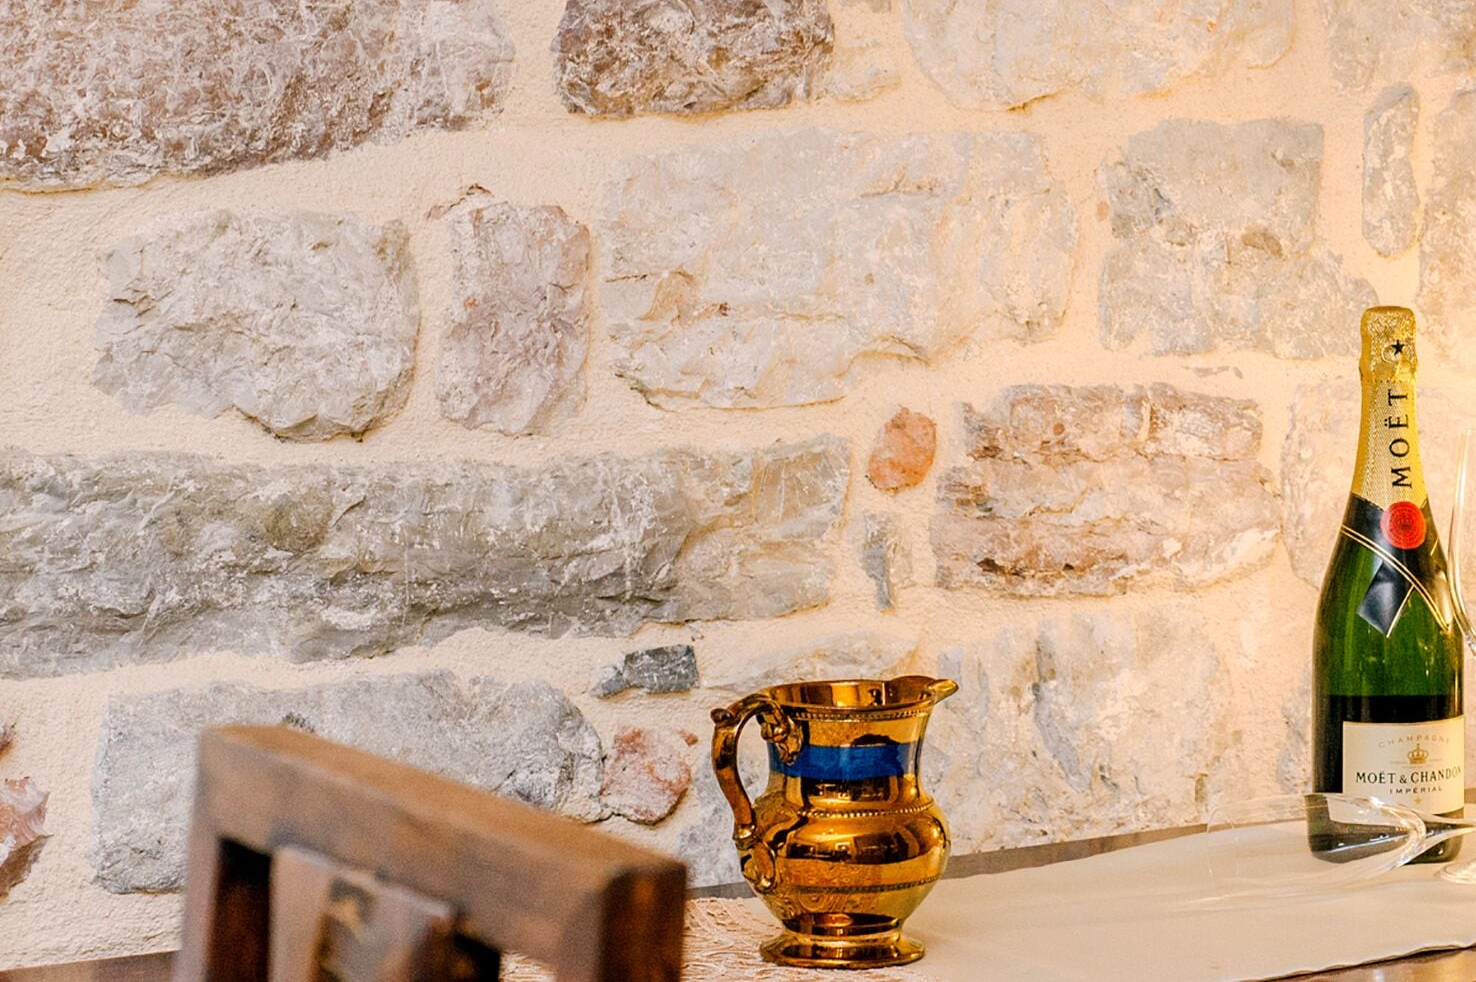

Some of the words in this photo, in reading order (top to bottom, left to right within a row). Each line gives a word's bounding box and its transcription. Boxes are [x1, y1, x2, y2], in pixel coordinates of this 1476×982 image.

[1384, 388, 1412, 489] MOËT
[1355, 771, 1396, 784] MOËT
[1399, 774, 1408, 784] &
